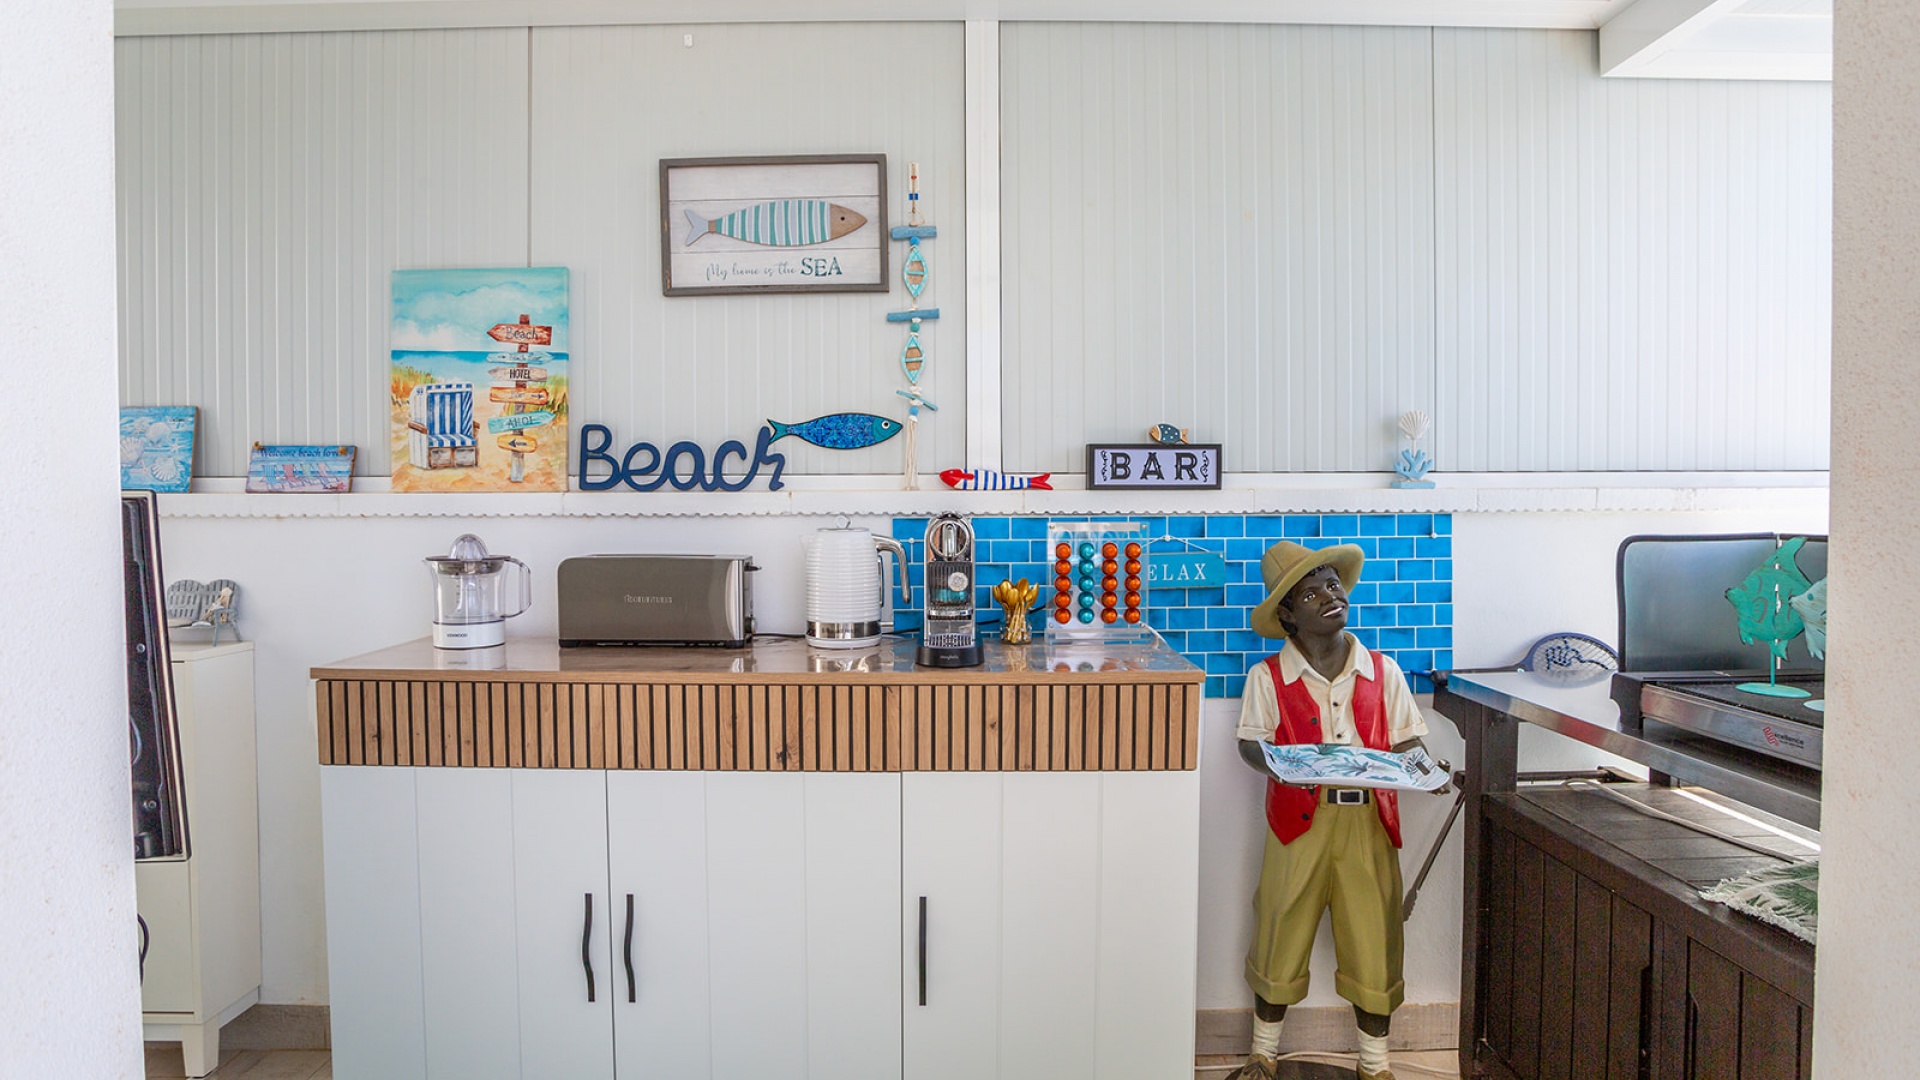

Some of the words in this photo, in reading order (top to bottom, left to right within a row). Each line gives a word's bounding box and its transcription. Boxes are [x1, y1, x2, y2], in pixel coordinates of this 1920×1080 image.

[706, 263, 728, 281] My
[773, 261, 797, 275] the
[800, 256, 843, 277] SEA
[504, 326, 539, 340] Beach
[509, 369, 531, 379] HOTEL
[508, 416, 534, 428] AHOI
[298, 447, 321, 458] beach
[579, 423, 785, 492] Beach
[1110, 452, 1198, 480] BAR
[1147, 563, 1207, 581] ELAX
